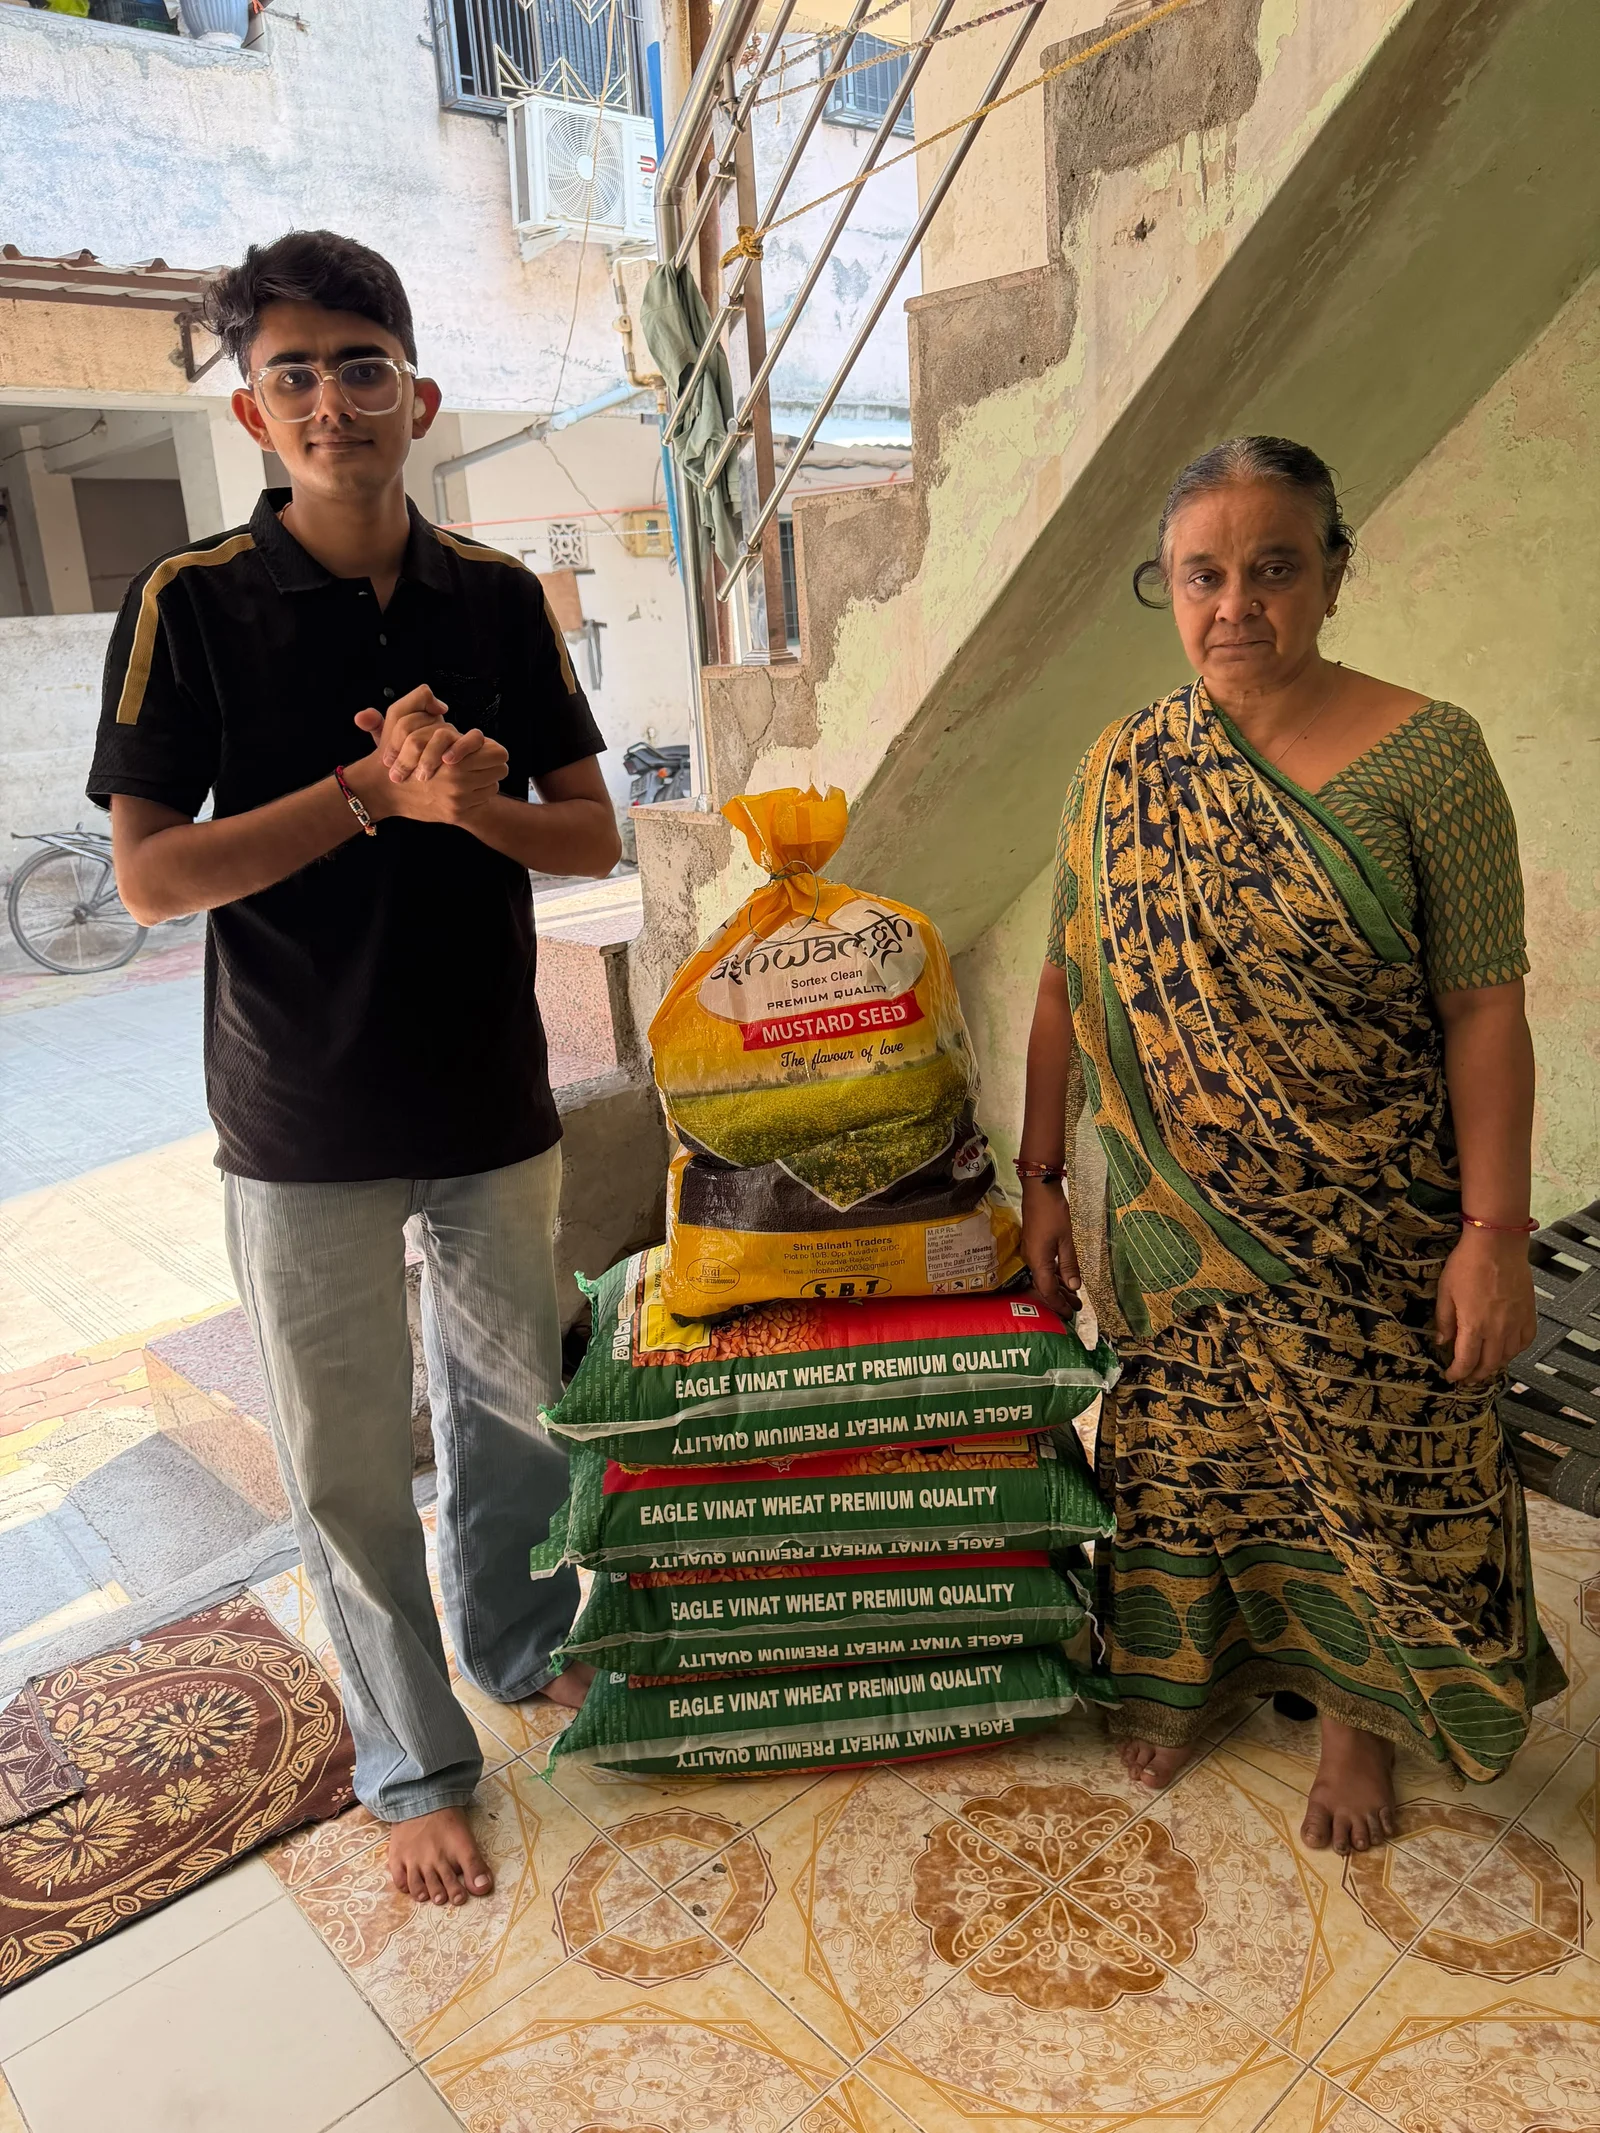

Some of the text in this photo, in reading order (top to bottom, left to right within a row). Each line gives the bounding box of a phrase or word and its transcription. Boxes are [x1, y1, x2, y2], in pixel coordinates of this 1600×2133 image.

[791, 969, 863, 989] Sortex Clean
[767, 985, 887, 1011] PREMIUM QUALITY
[762, 1005, 907, 1043] MUSTARD SEED
[781, 1039, 904, 1070] The flavour of love
[793, 1237, 892, 1251] Shri Bilnath Traders
[927, 1254, 940, 1262] Best
[941, 1252, 959, 1260] Before
[928, 1262, 943, 1270] From
[953, 1258, 966, 1266] Date
[675, 1347, 1032, 1399] EAGLE VINAT WHEAT PREMIUM QUALITY
[672, 1404, 1033, 1455] EAGLE VINAT WHEAT PREMIUM QUALITY
[640, 1486, 997, 1526] EAGLE VINAT WHEAT PREMIUM QUALITY
[650, 1537, 1006, 1570] EAGLE VINAT WHEAT PREMIUM QUALITY
[671, 1599, 724, 1621] EAGLE
[728, 1595, 781, 1618] VINAT
[785, 1592, 847, 1614] WHEAT
[852, 1587, 934, 1610] PREMIUM
[938, 1583, 1015, 1607] QUALITY
[678, 1633, 1024, 1668] EAGLE VINAT WHEAT PREMIUM QUALITY
[669, 1665, 1003, 1719] EAGLE VINAT WHEAT PREMIUM QUALITY
[676, 1718, 1015, 1768] EAGLE VINAT WHEAT PREMIUM QUALITY
